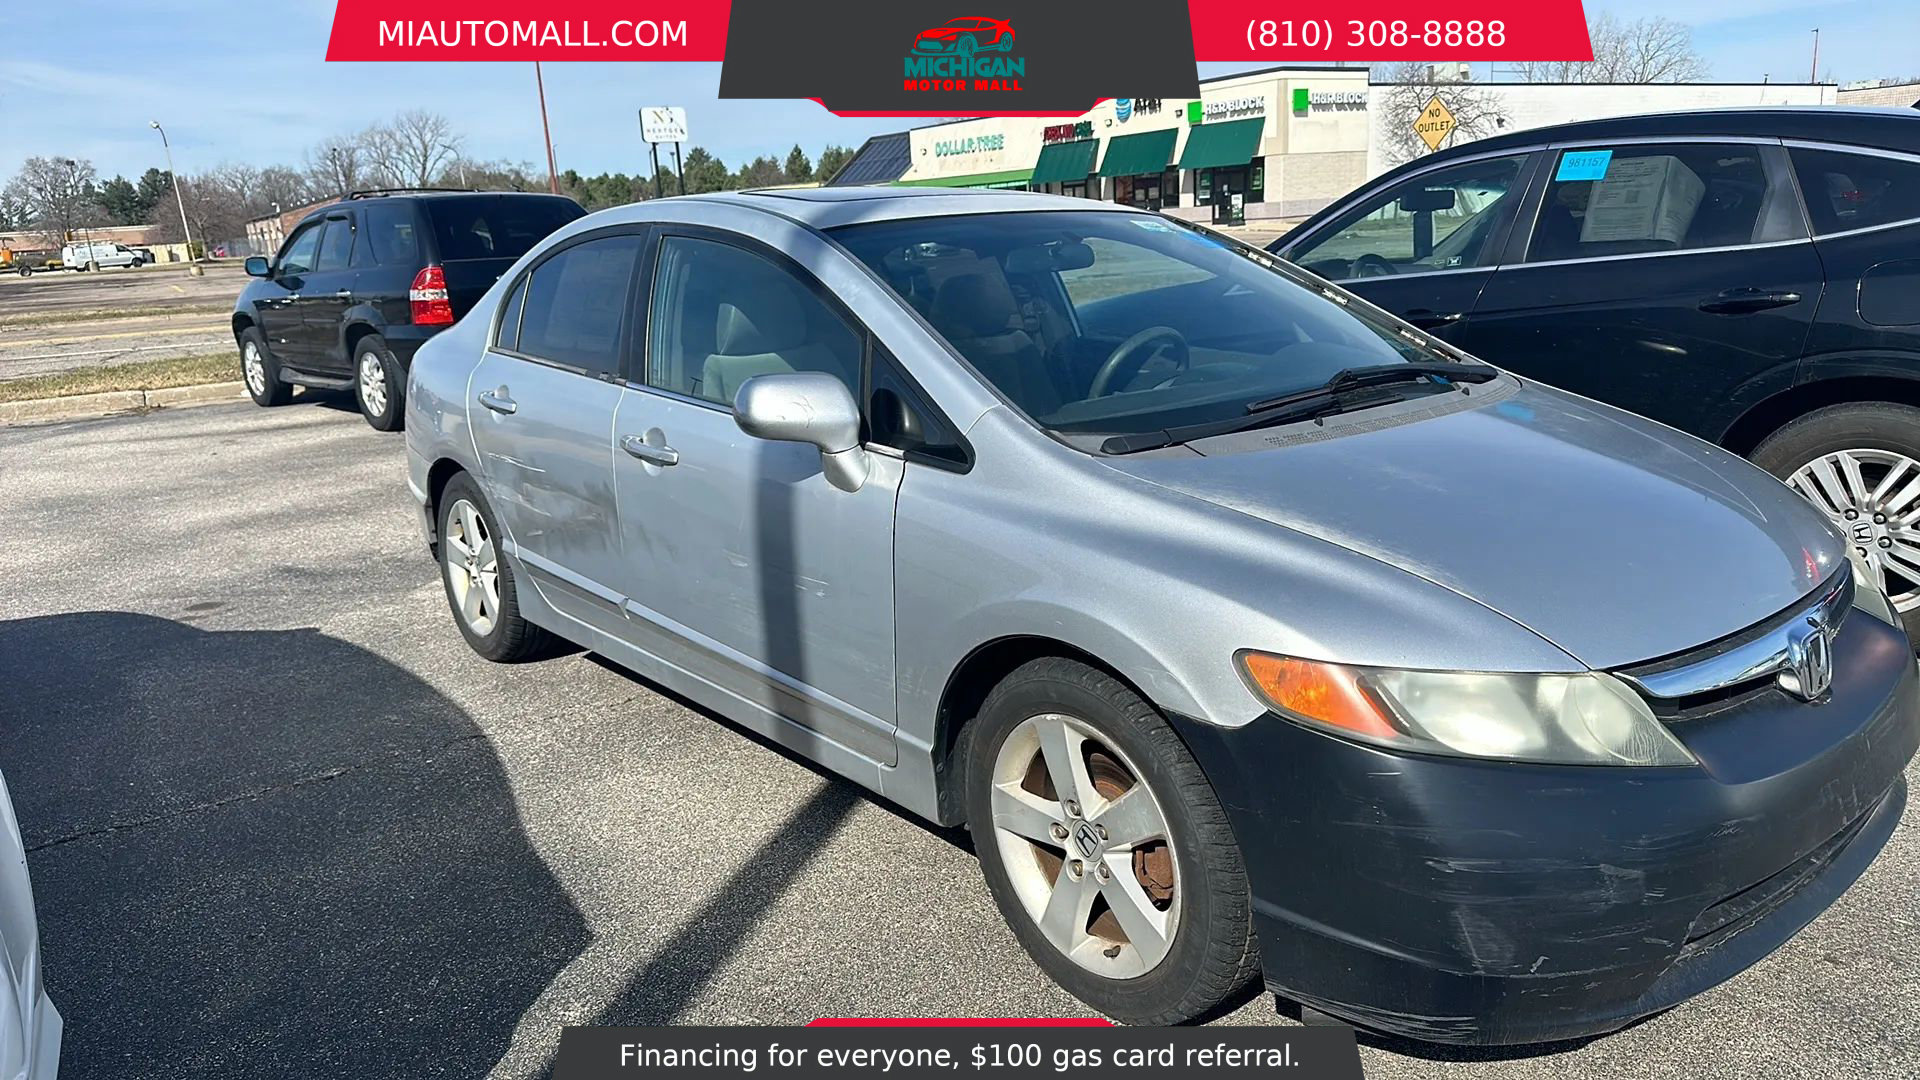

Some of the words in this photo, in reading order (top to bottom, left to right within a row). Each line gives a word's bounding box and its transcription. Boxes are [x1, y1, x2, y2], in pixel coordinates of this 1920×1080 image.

[1335, 91, 1368, 104] BLOCK
[1228, 96, 1266, 113] BLOCK
[1428, 108, 1441, 119] NO
[1418, 120, 1451, 133] OUTLET
[935, 137, 975, 157] DOLLAR
[976, 133, 1005, 153] TREE
[1567, 157, 1605, 169] 981157
